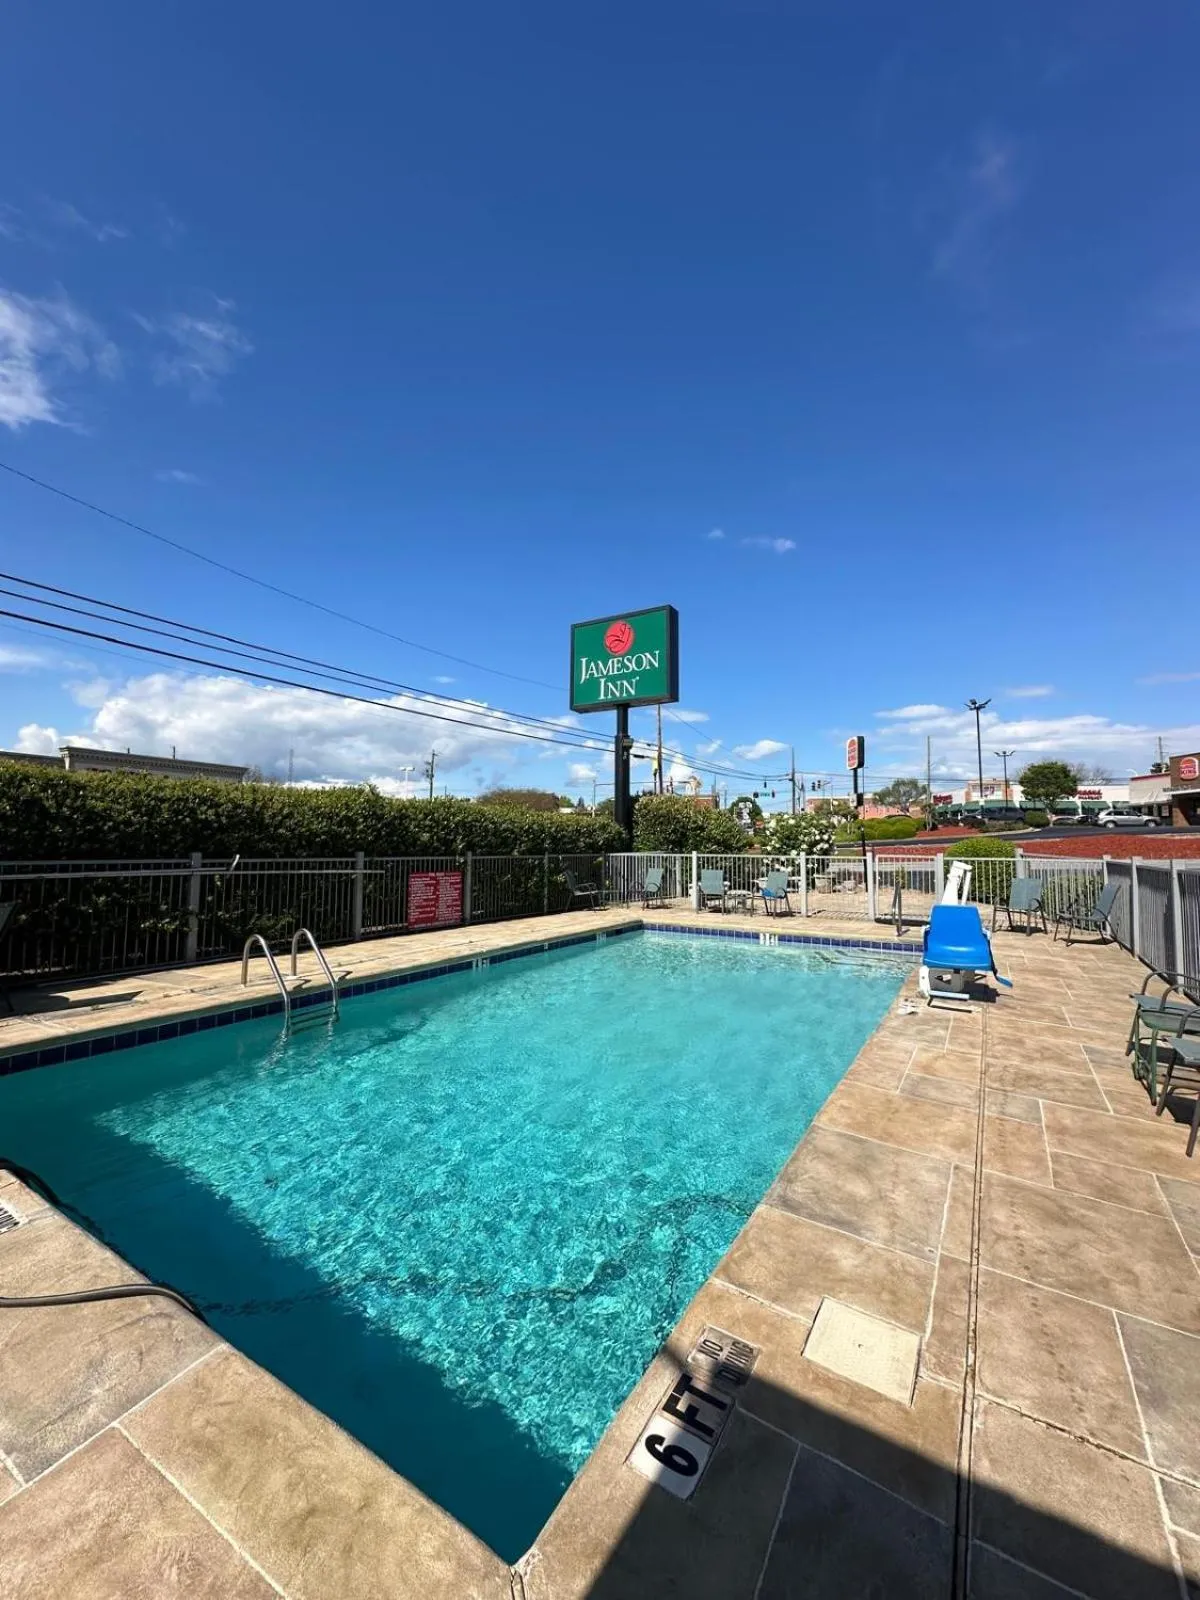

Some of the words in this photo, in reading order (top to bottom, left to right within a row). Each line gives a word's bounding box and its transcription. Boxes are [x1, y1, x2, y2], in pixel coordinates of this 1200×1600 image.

[580, 650, 660, 684] JAMESON
[597, 678, 637, 700] INN
[697, 1339, 724, 1361] NO
[715, 1340, 754, 1386] DIVING
[661, 1373, 729, 1438] FT
[644, 1433, 699, 1477] 6
